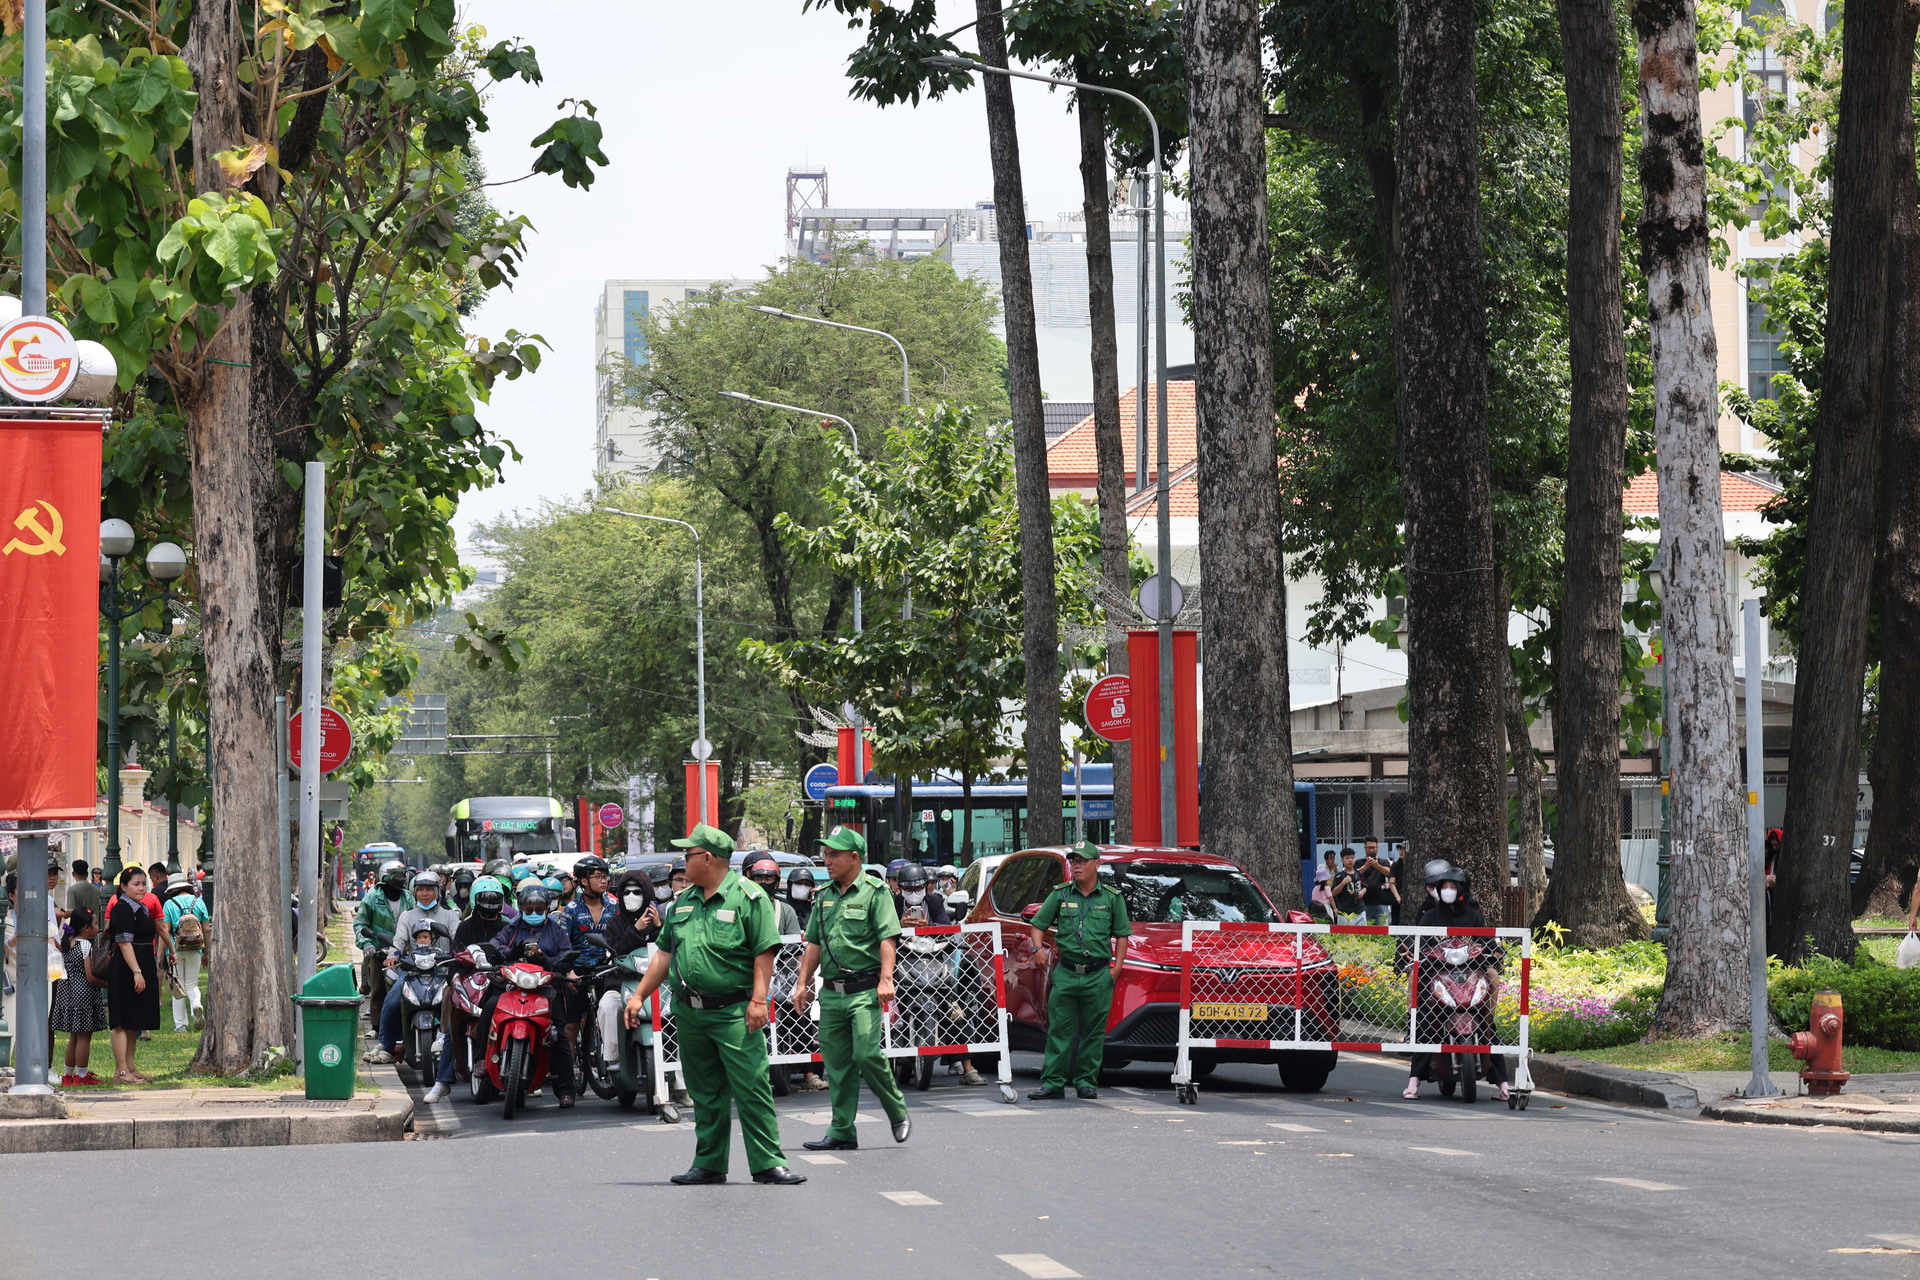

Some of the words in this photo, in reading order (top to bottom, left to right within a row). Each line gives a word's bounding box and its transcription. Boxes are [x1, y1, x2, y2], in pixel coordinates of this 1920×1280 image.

[1101, 719, 1122, 727] SAIGON
[923, 811, 933, 820] 36
[1822, 835, 1836, 846] 37
[1670, 839, 1694, 855] 168
